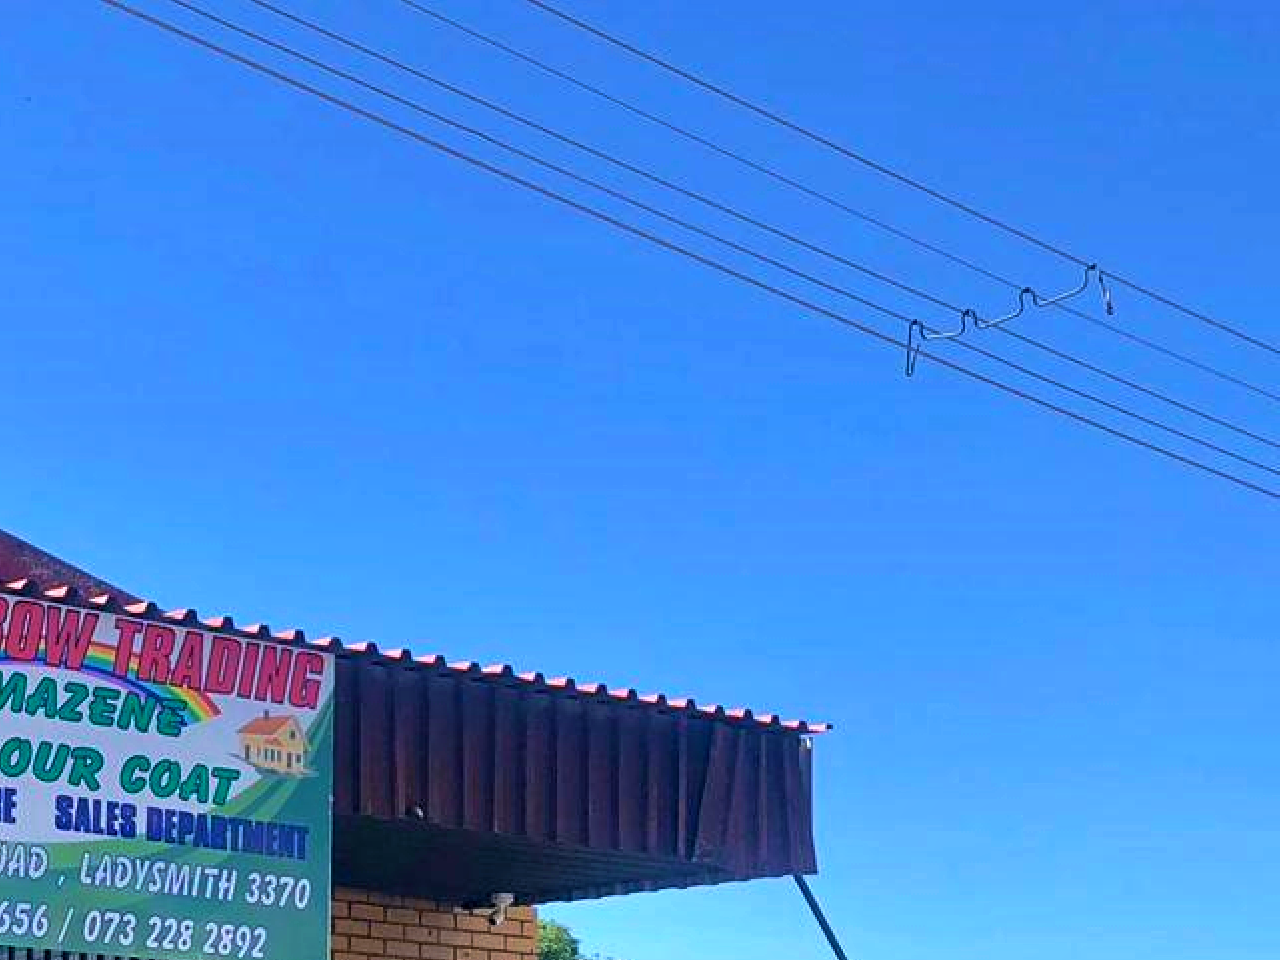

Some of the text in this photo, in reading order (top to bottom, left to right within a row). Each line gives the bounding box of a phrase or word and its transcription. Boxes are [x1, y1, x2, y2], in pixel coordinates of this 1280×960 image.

[112, 614, 325, 709] TRADING
[118, 754, 241, 806] COAT
[54, 794, 137, 839] SALES
[145, 806, 312, 861] DEPARTMENT
[79, 852, 238, 901] LADYSMITH
[247, 872, 312, 910] 3370
[83, 910, 137, 946] 073
[146, 916, 193, 952] 228
[202, 923, 267, 959] 2892
